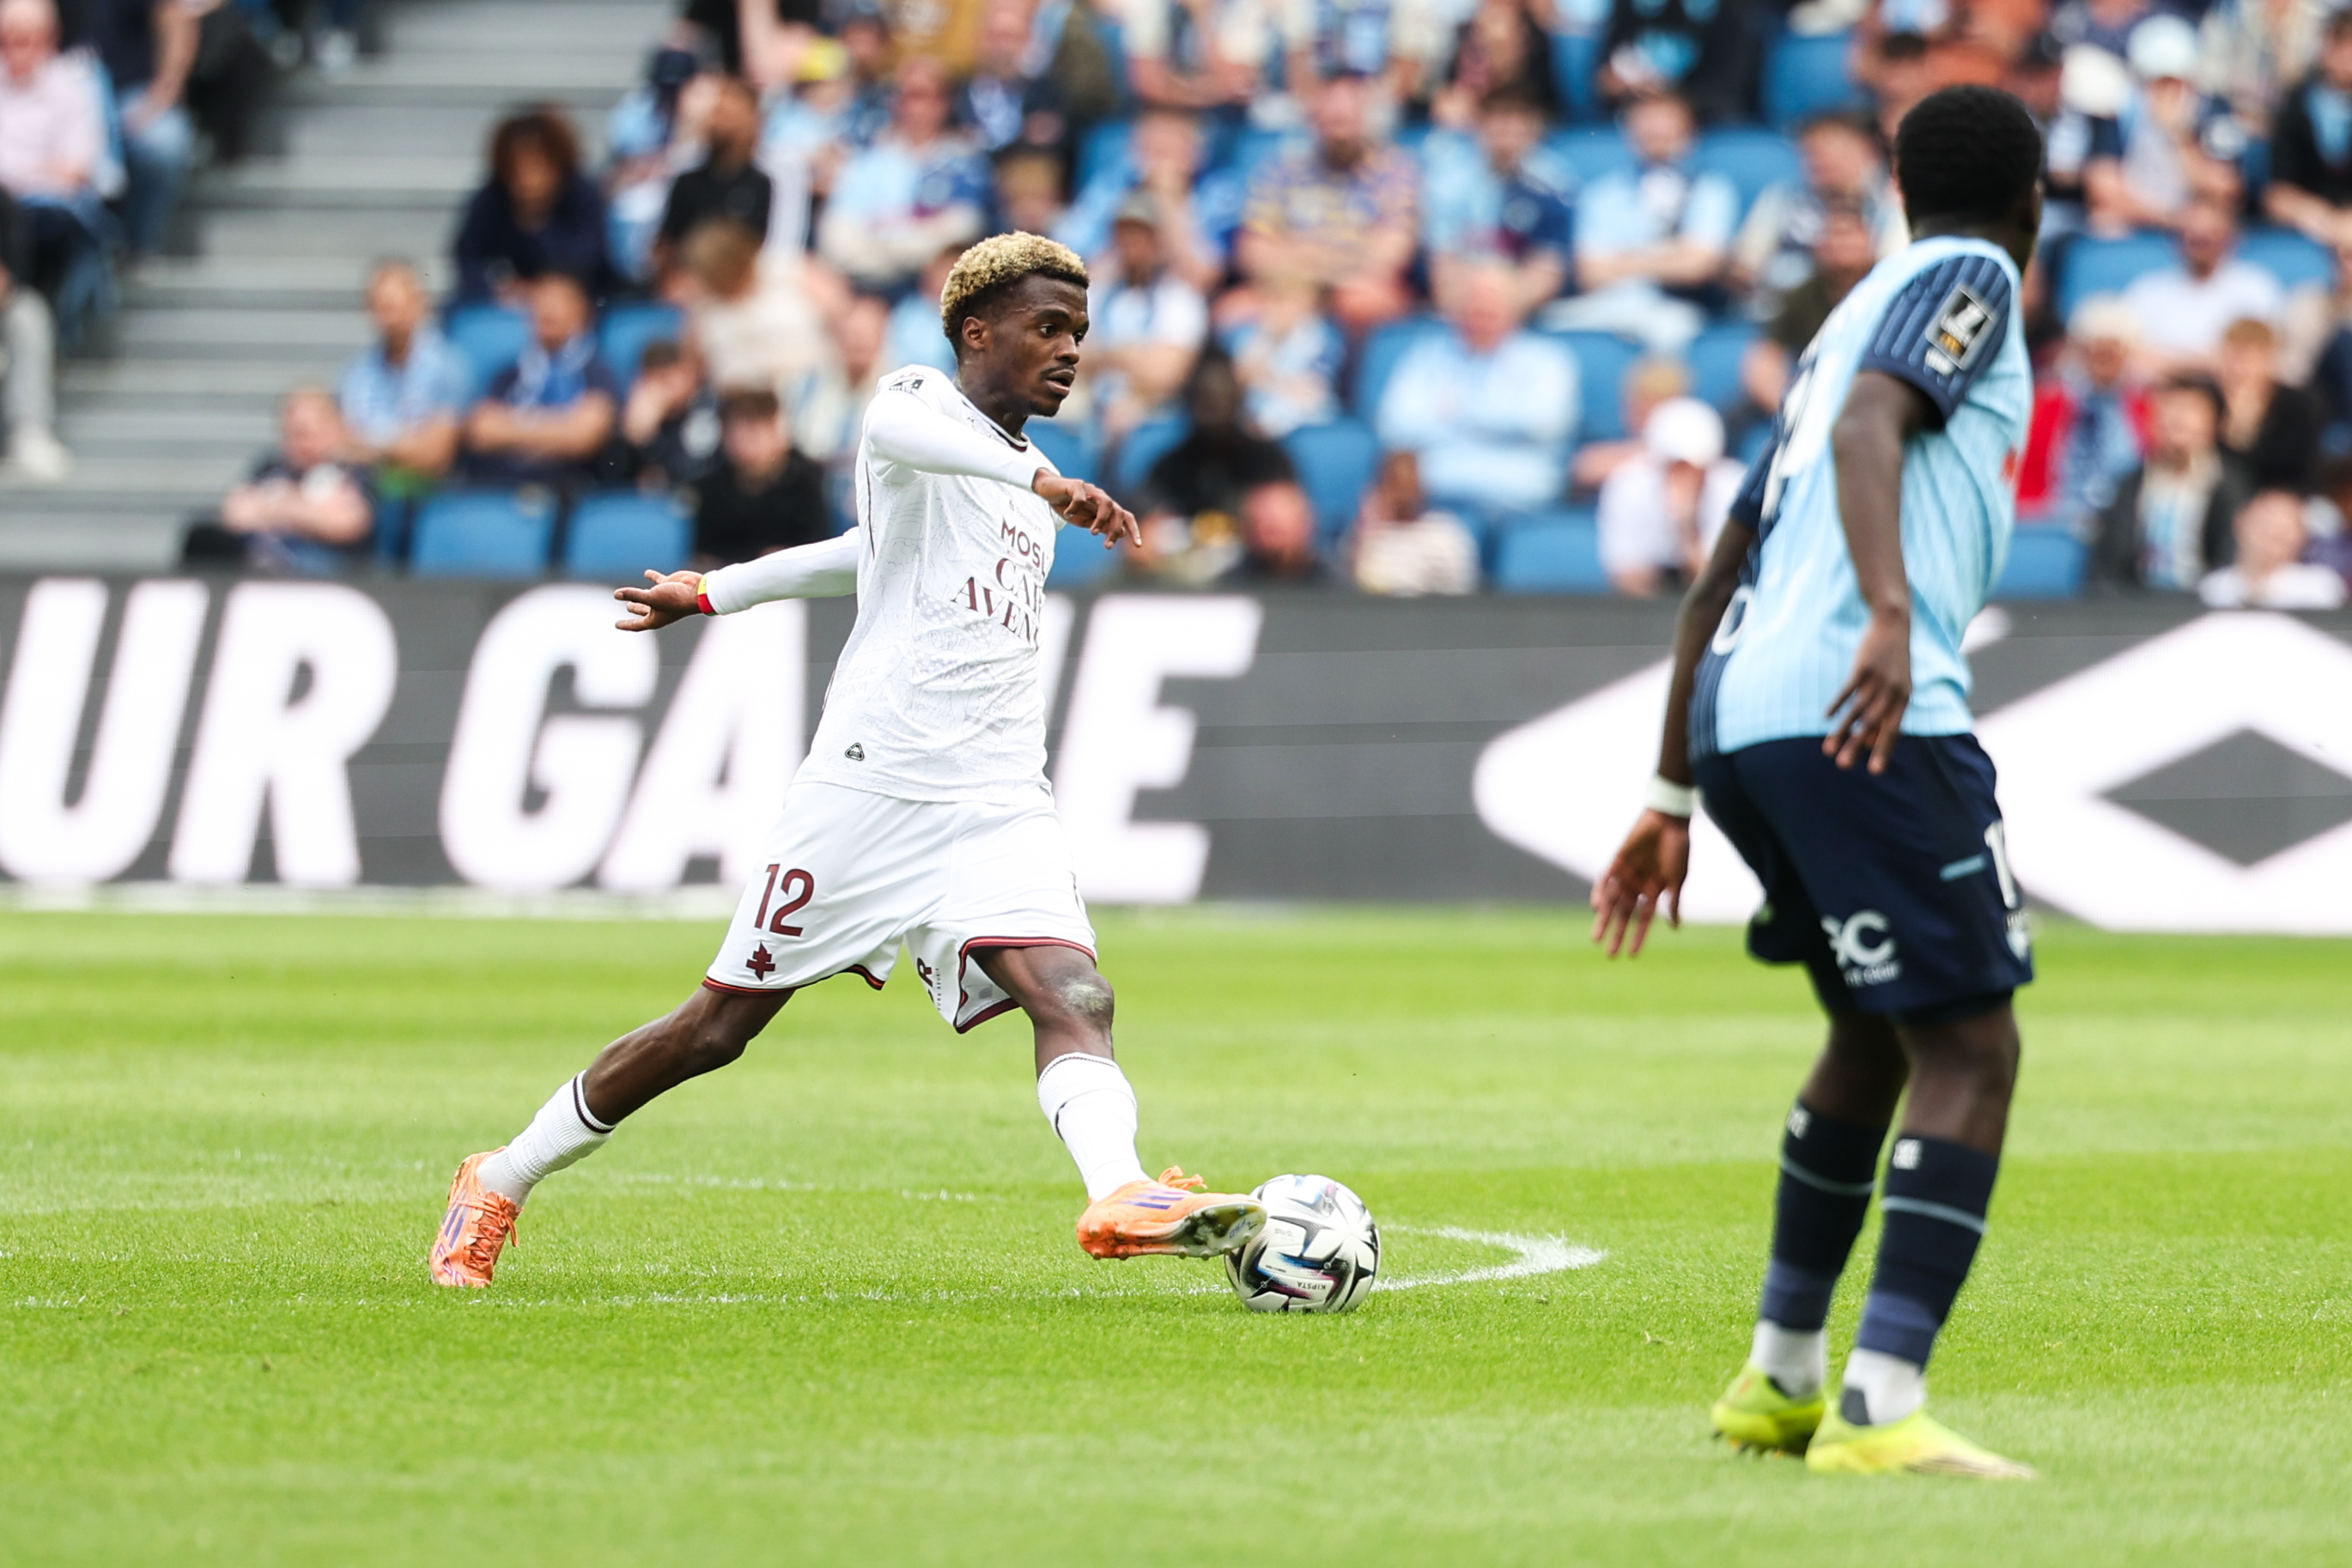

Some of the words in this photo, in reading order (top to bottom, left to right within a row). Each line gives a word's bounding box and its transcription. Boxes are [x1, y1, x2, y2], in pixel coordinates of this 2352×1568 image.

[0, 577, 399, 884] UR
[754, 864, 814, 937] 12
[1297, 1281, 1327, 1291] KIPSTA
